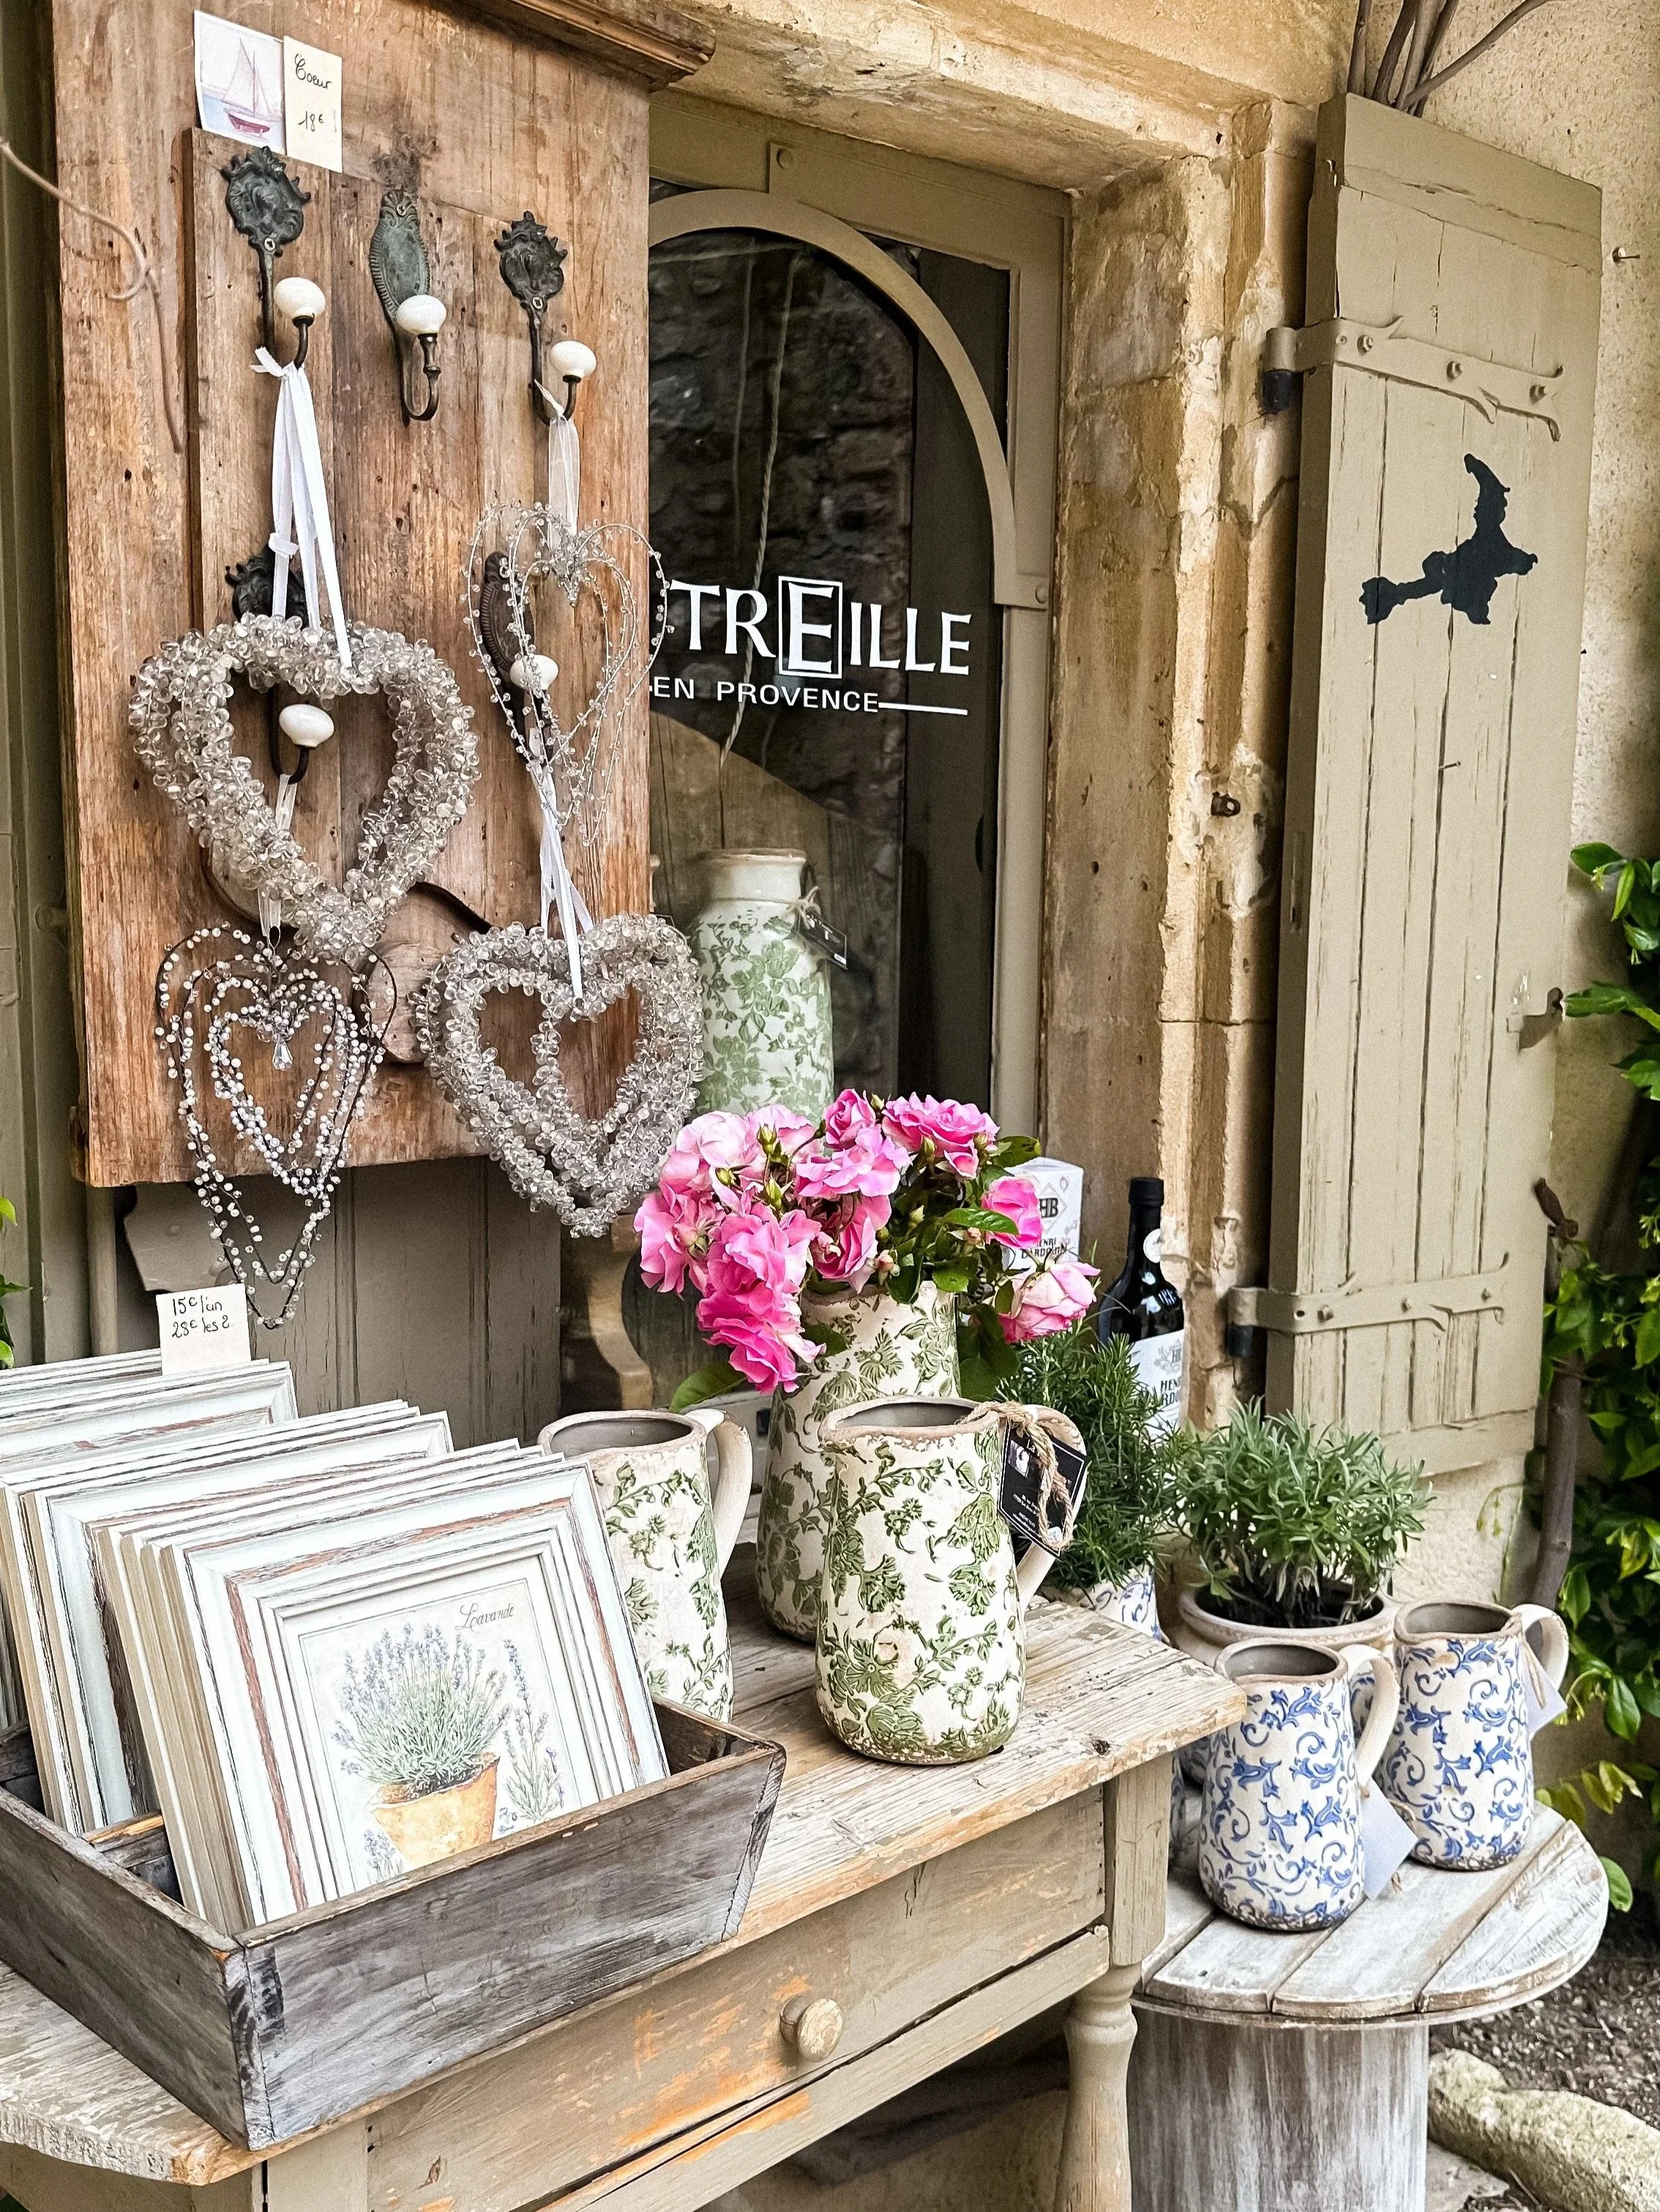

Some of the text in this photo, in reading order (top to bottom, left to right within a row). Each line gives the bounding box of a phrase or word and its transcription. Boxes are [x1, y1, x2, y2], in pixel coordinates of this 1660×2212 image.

[294, 53, 333, 89] Coeur
[297, 110, 324, 132] 18€
[669, 578, 972, 676] TREILLE
[654, 677, 879, 713] EN PROVENCE
[1039, 1197, 1059, 1219] HB
[172, 1297, 198, 1316] 15€
[171, 1314, 230, 1338] 28€ les 2
[455, 1602, 515, 1633] Lavande
